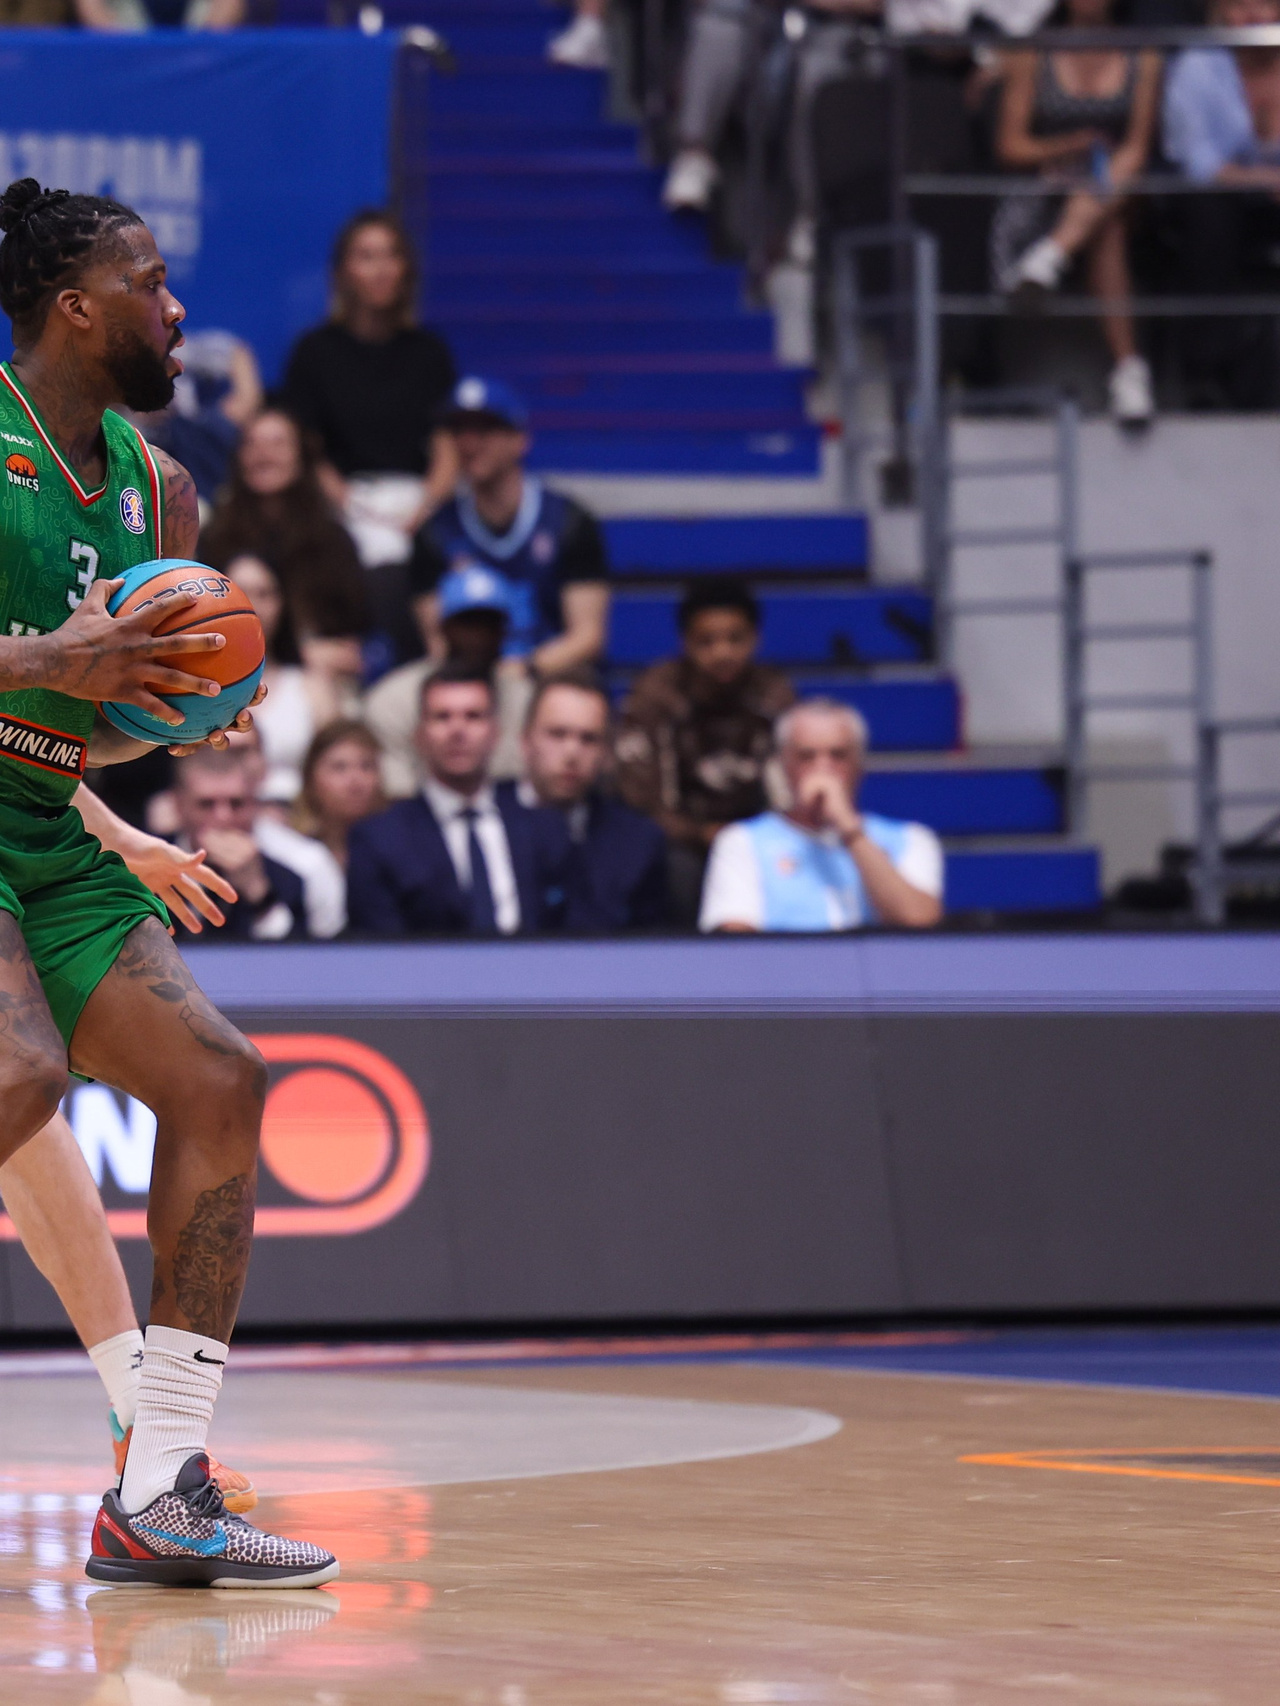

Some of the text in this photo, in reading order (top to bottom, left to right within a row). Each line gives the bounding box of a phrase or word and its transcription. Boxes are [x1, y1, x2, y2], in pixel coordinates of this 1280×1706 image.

[0, 431, 34, 448] MAXX
[6, 469, 39, 492] UNICS
[66, 537, 101, 613] 3
